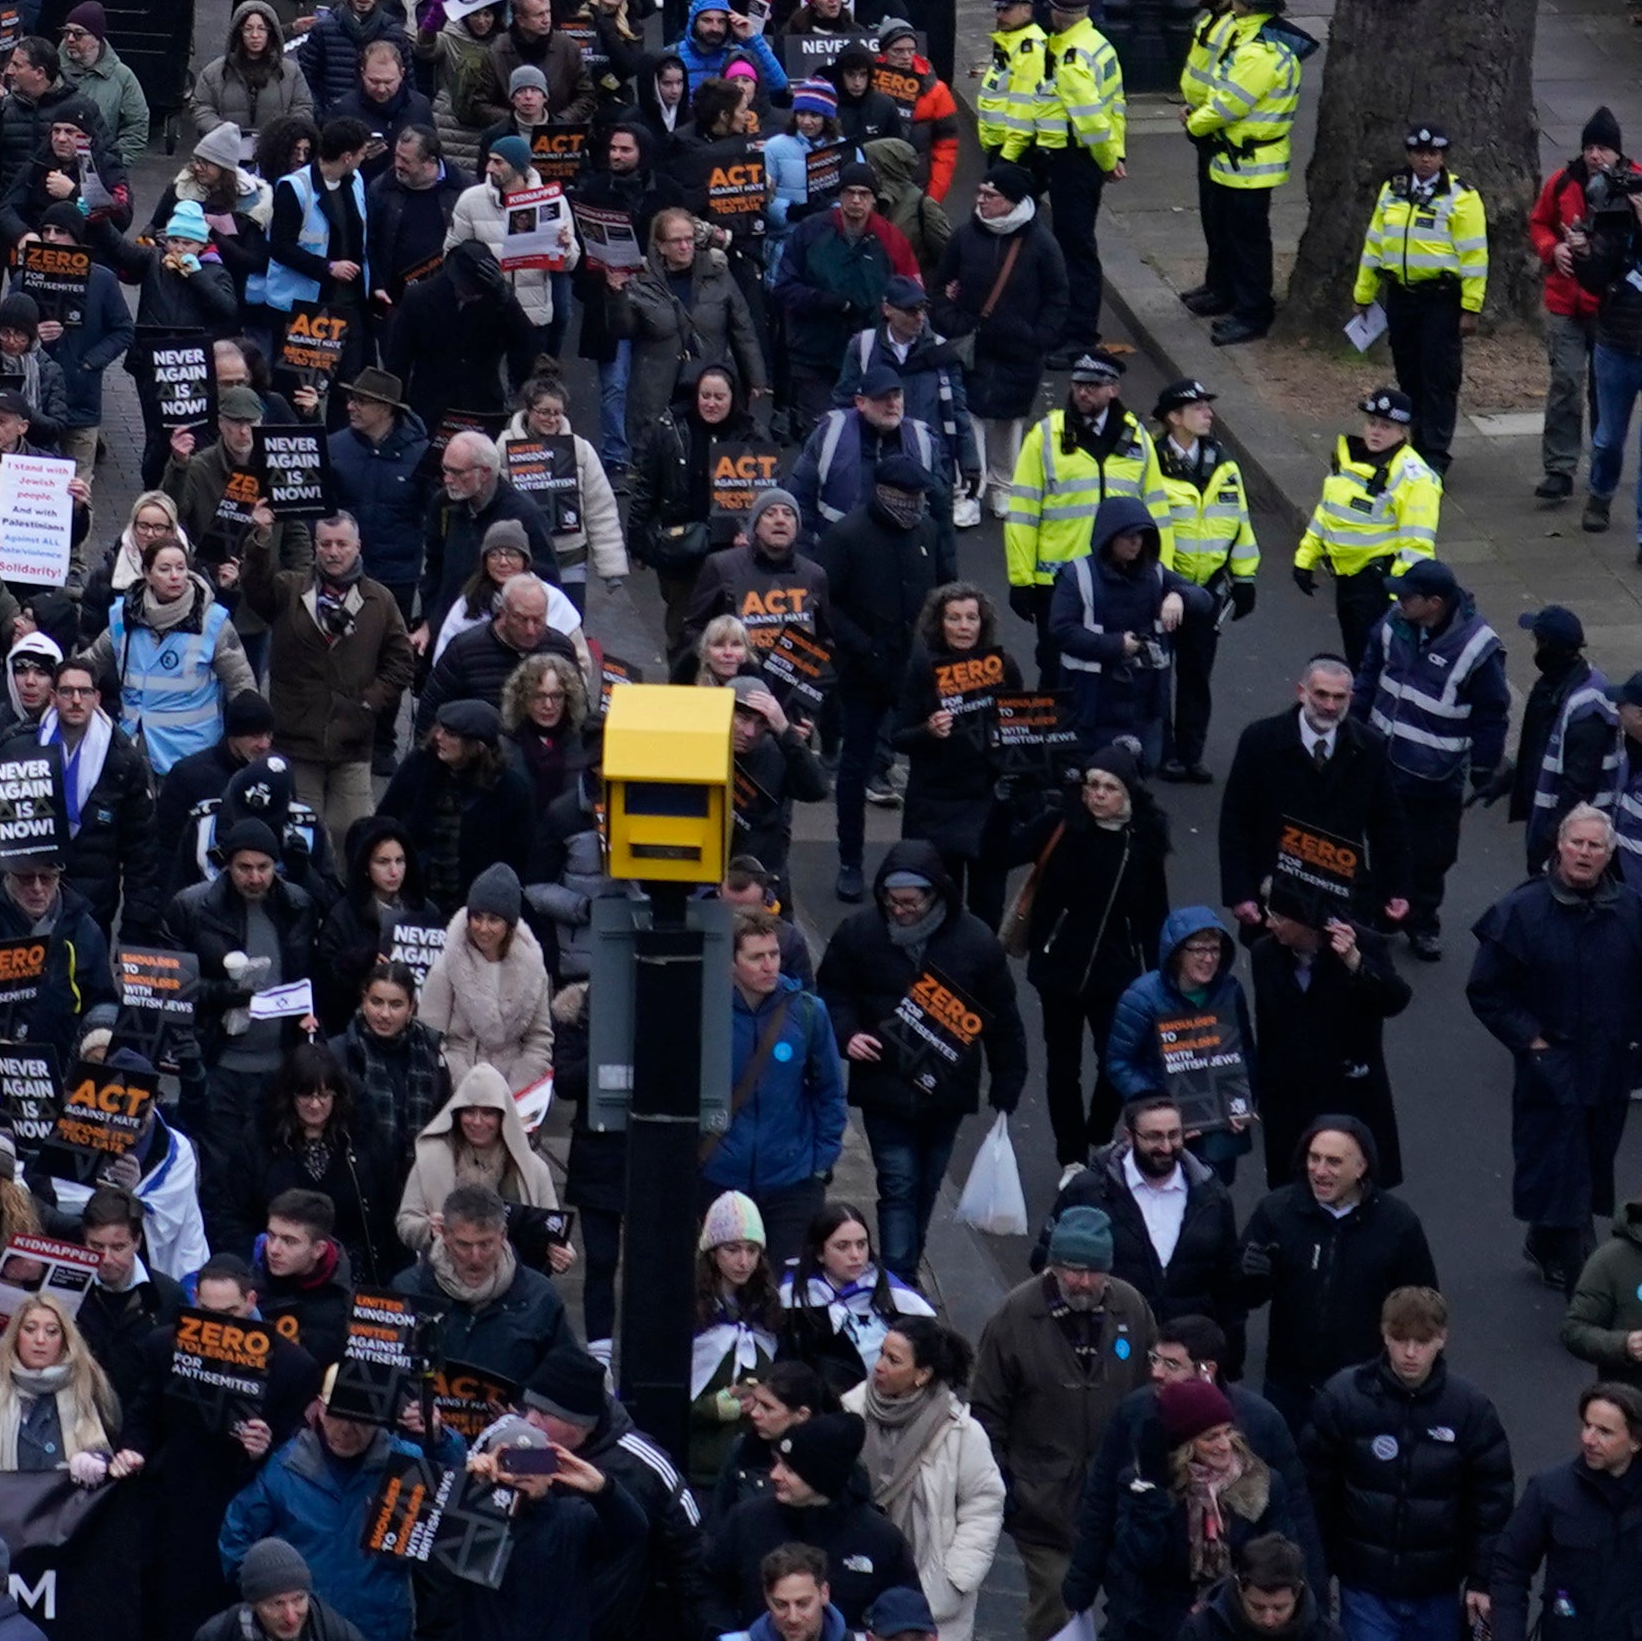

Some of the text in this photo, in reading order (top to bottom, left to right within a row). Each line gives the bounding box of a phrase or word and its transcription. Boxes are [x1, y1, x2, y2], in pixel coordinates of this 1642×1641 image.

[709, 163, 763, 188] ACT
[290, 313, 348, 341] ACT
[153, 349, 205, 367] NEVER
[155, 366, 207, 384] AGAIN
[264, 438, 320, 453] NEVER
[14, 463, 44, 475] stand
[46, 467, 70, 477] with
[266, 454, 320, 470] AGAIN
[714, 456, 777, 480] ACT
[19, 477, 56, 488] Jewish
[13, 506, 58, 518] And with
[2, 518, 65, 533] Palestinians
[5, 535, 60, 548] Against ALL
[742, 588, 808, 618] ACT
[937, 655, 1004, 681] ZERO
[1280, 825, 1358, 870] ZERO
[123, 996, 194, 1014] BRITISH JEWS
[914, 971, 985, 1036] ZERO
[1166, 1052, 1241, 1074] BRITISH JEWS
[2, 1078, 55, 1099] AGAIN
[68, 1079, 150, 1117] ACT
[14, 1236, 100, 1264] KIDNAPPED
[176, 1316, 270, 1357] ZERO
[347, 1336, 406, 1354] AGAINST
[172, 1363, 260, 1396] ANTISEMITES
[418, 1470, 457, 1563] BRITISH JEWS
